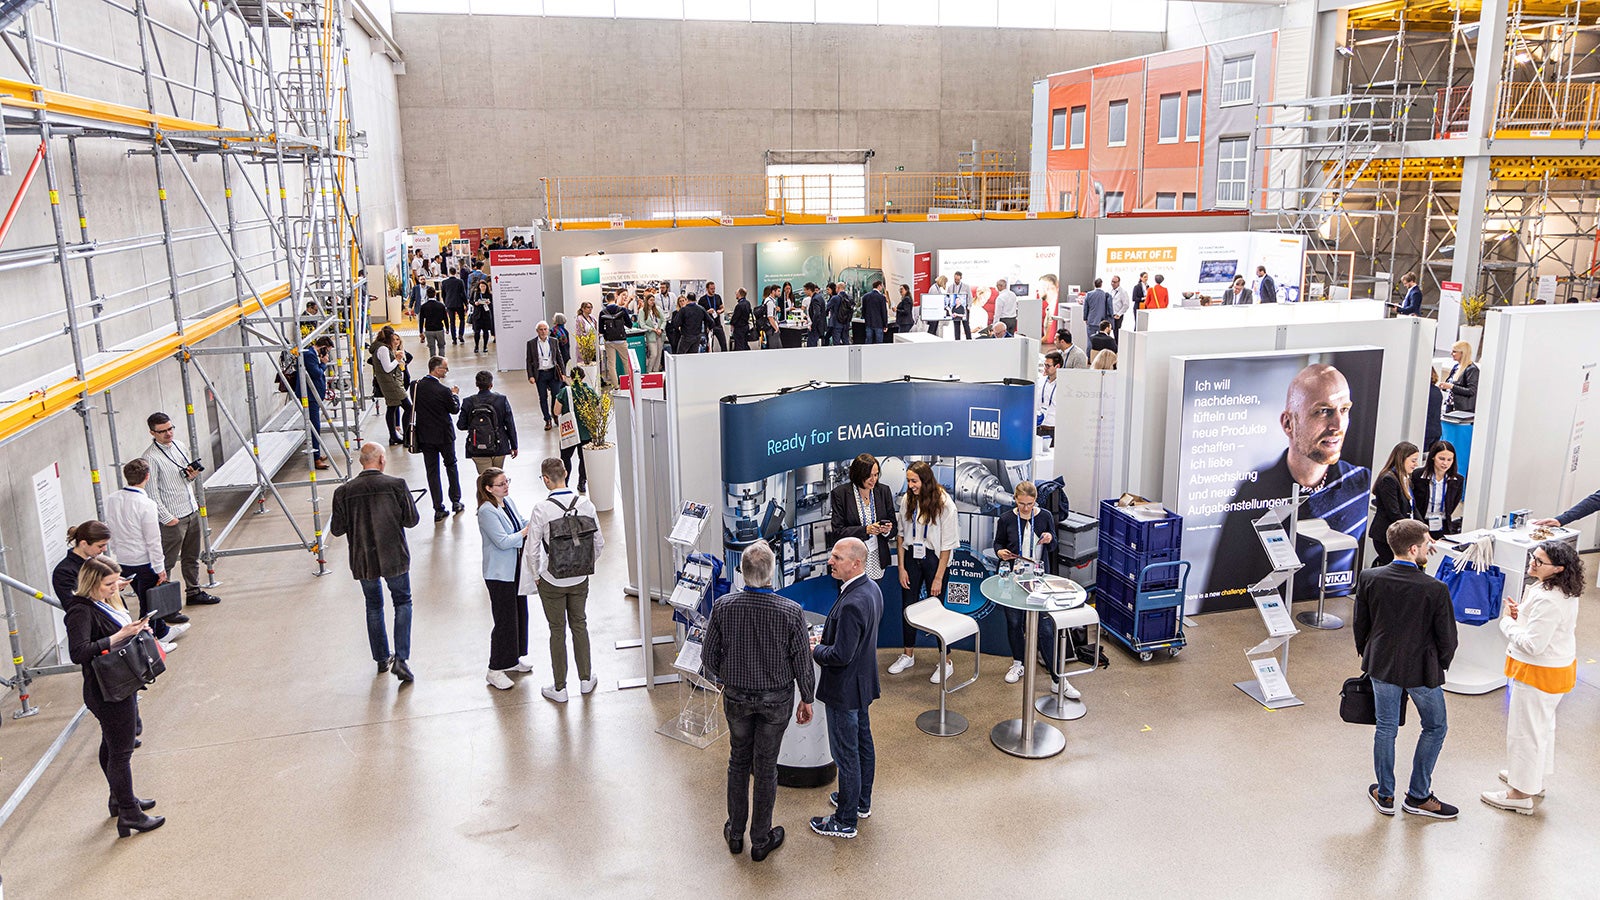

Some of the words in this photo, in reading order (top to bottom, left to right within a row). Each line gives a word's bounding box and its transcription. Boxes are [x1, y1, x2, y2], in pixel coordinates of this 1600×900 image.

[1110, 251, 1122, 260] BE
[1124, 250, 1147, 260] PART
[1149, 250, 1161, 259] OF
[1162, 250, 1173, 259] IT.
[1195, 380, 1211, 391] Ich
[1214, 379, 1231, 390] will
[1194, 394, 1261, 407] nachdenken,
[1193, 410, 1225, 423] tüfteln
[1227, 409, 1248, 420] und
[560, 419, 574, 433] PERI
[971, 420, 998, 439] EMAG
[1192, 428, 1219, 438] neue
[1221, 424, 1267, 437] Produkte
[767, 433, 807, 456] Ready
[810, 428, 833, 445] for
[837, 421, 954, 442] EMAGination?
[1191, 441, 1235, 454] schaffen
[1190, 459, 1206, 470] Ich
[1208, 457, 1233, 468] liebe
[1189, 470, 1258, 485] Abwechslung
[1188, 490, 1208, 501] und
[1210, 487, 1237, 498] neue
[1187, 498, 1290, 517] Aufgabenstellungen.
[961, 560, 975, 568] the
[960, 569, 984, 578] Team!
[1221, 587, 1247, 597] challenge
